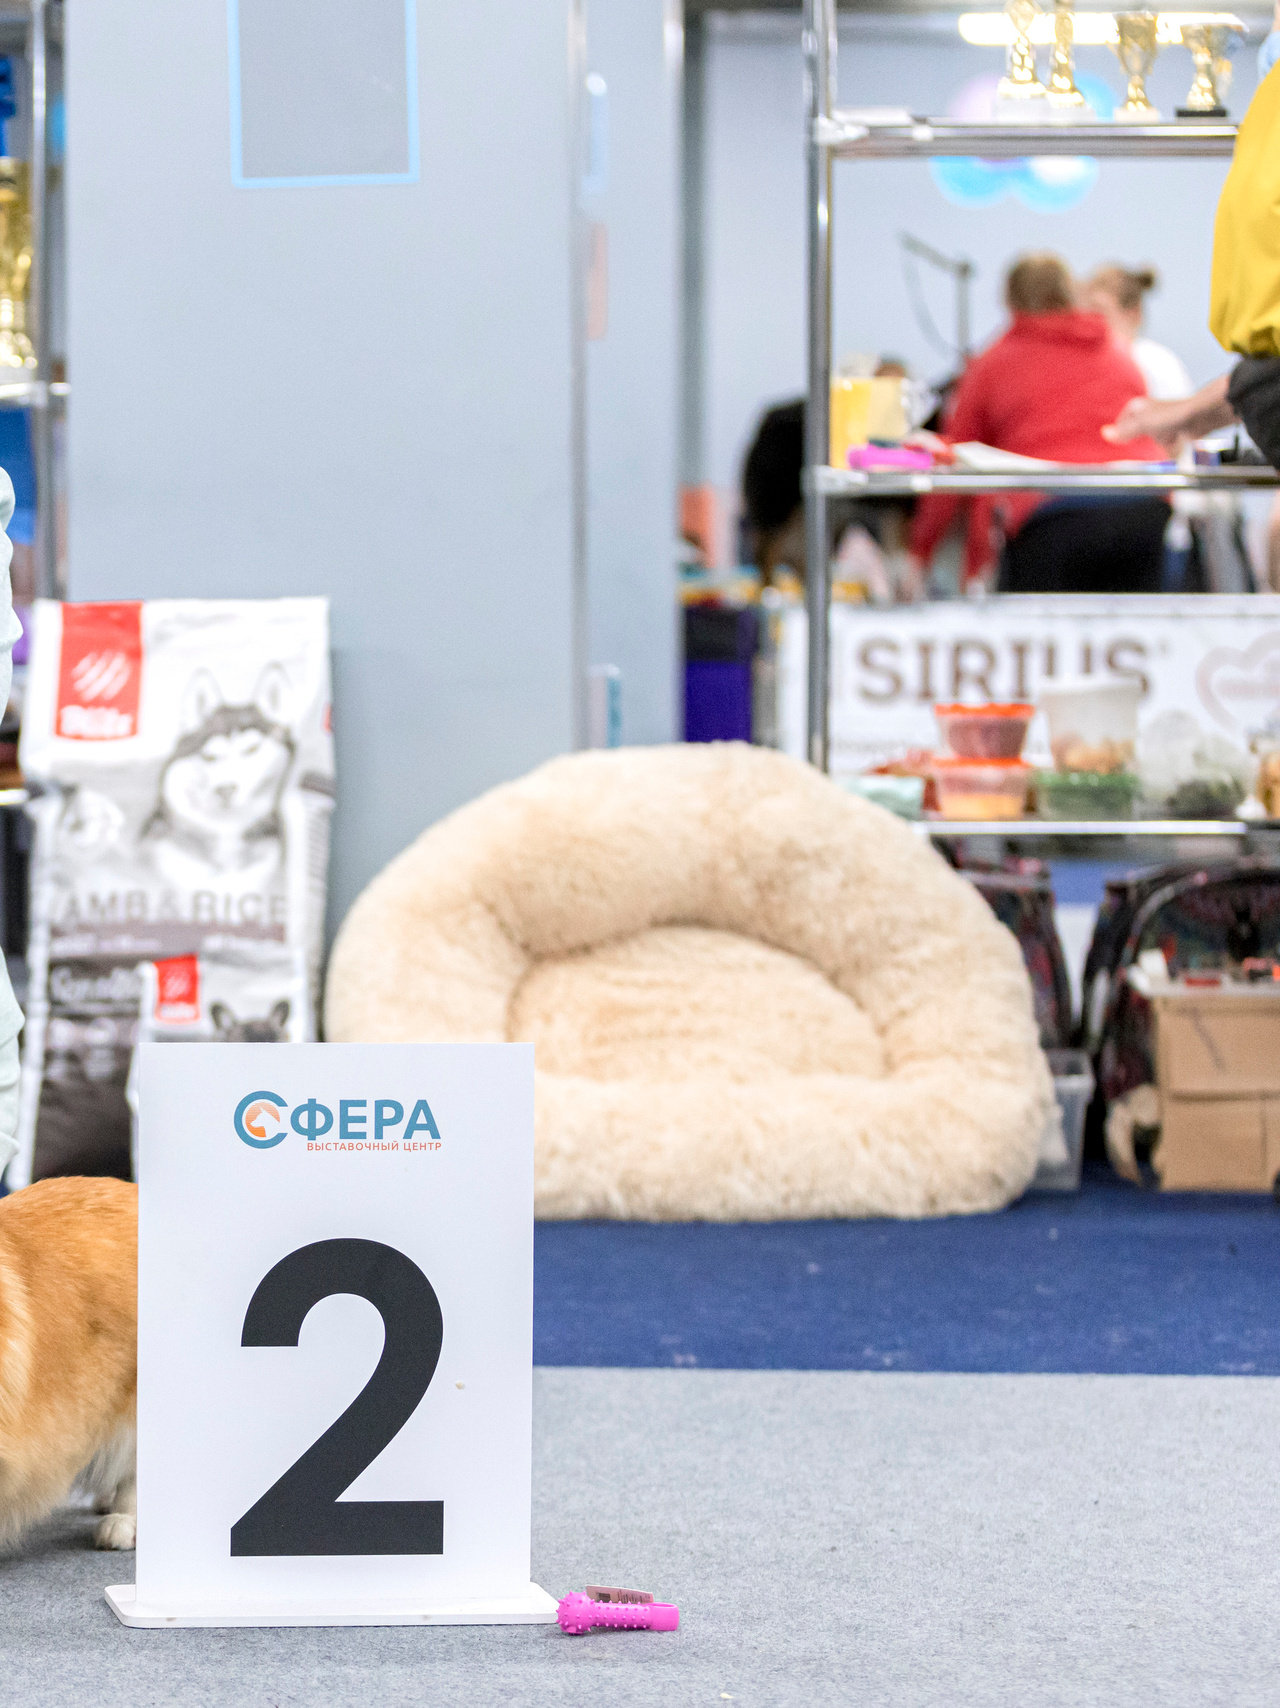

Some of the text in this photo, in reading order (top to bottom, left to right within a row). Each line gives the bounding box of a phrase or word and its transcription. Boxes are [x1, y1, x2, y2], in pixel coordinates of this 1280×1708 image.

[857, 634, 1150, 704] SIRIUS
[234, 1090, 441, 1149] СФЕРА
[307, 1141, 442, 1152] ВЫСТАВОЧНЫЙ ЦЕНТР
[230, 1237, 445, 1557] 2
